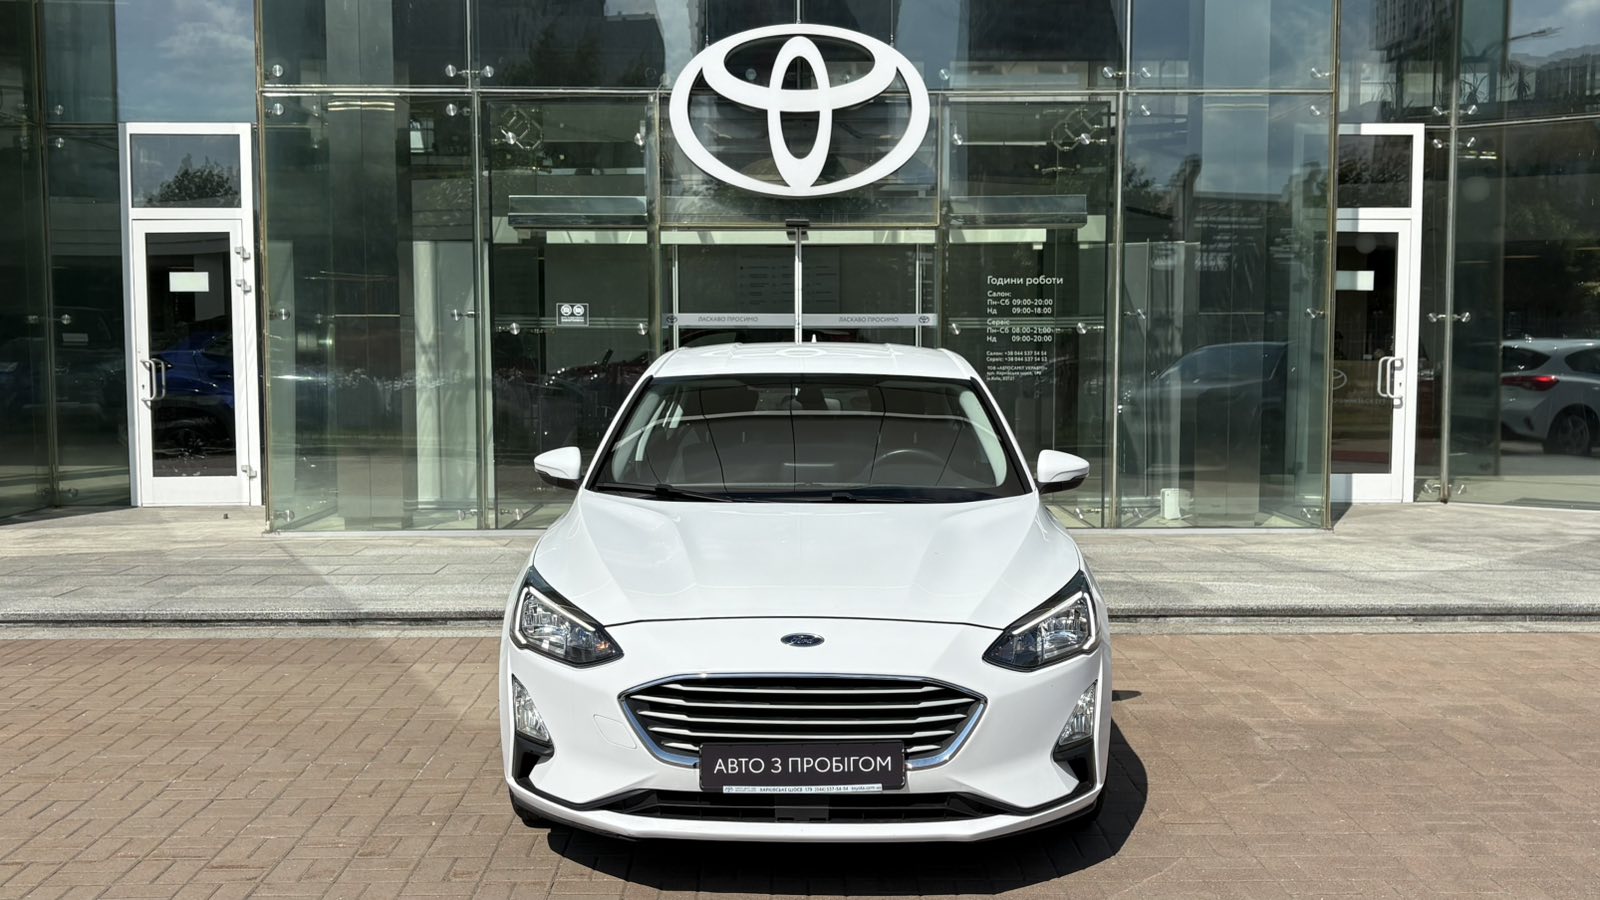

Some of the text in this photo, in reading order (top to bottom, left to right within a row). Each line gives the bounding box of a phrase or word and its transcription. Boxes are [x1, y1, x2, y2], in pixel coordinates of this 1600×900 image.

[987, 275, 1064, 286] Години роботи
[714, 756, 892, 774] АВТО З ПРОБІГОМ
